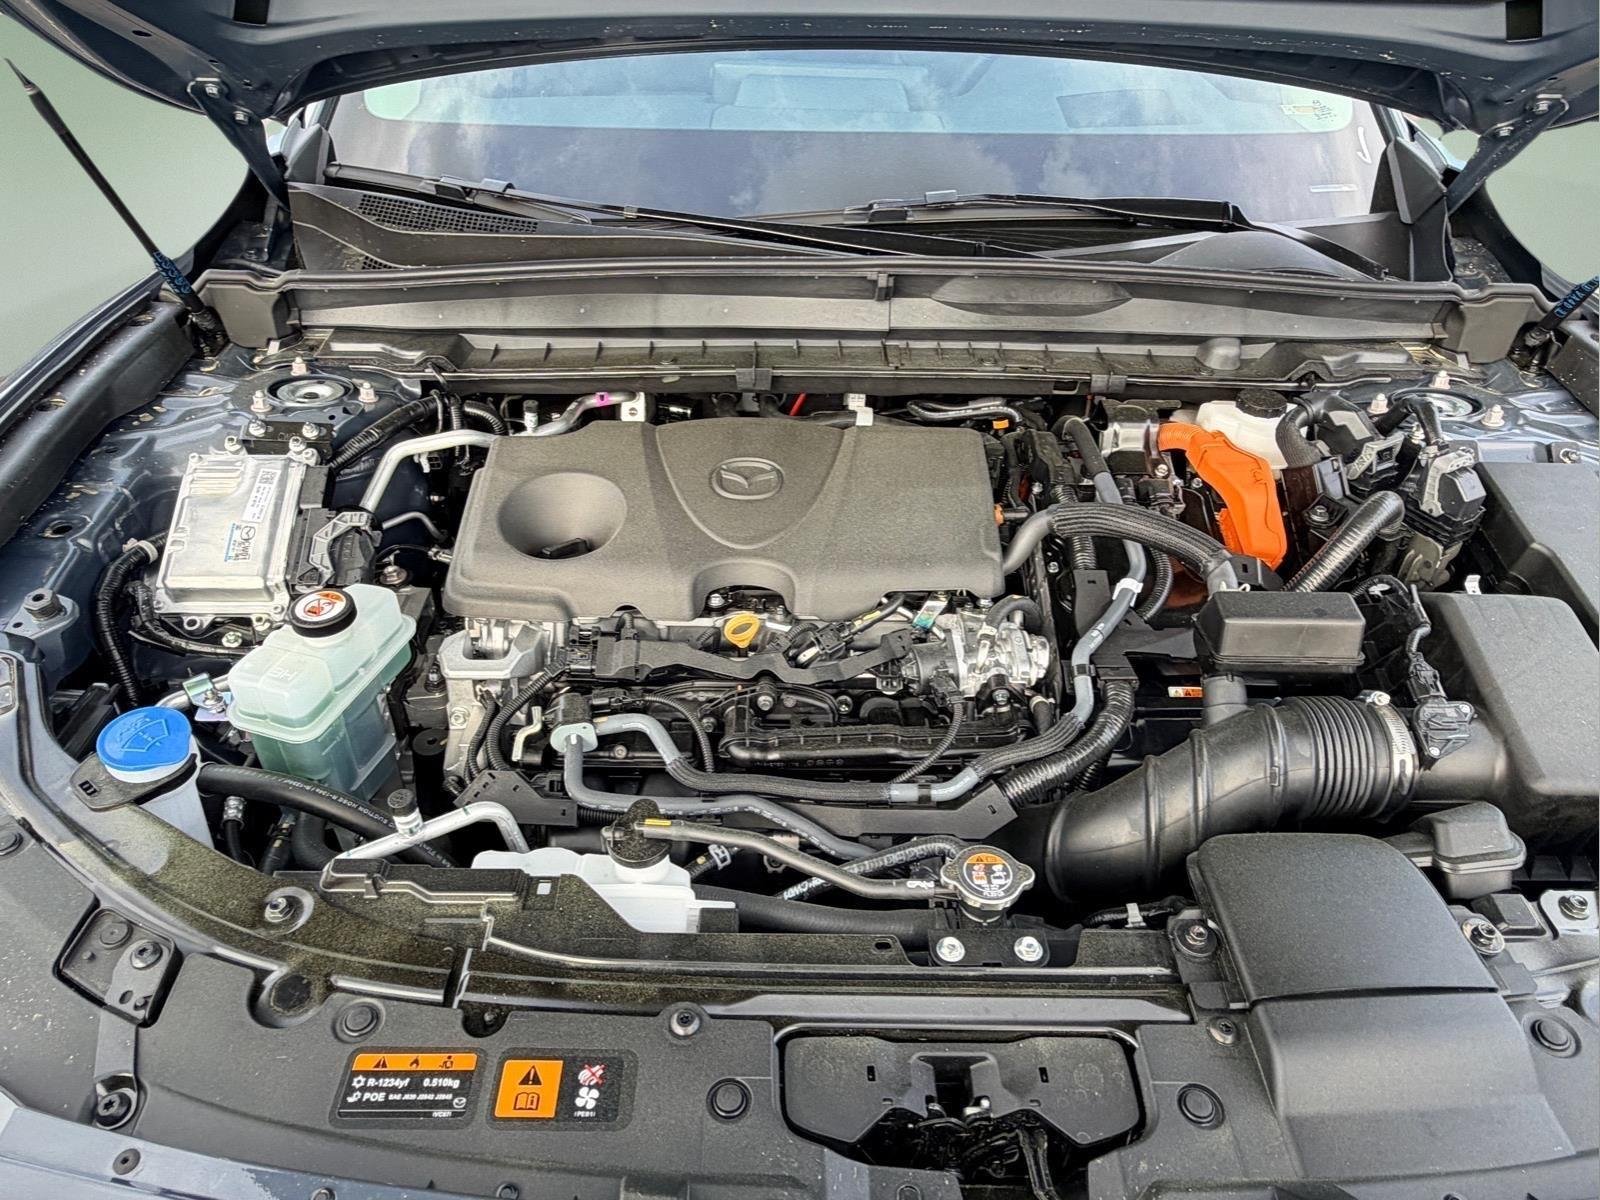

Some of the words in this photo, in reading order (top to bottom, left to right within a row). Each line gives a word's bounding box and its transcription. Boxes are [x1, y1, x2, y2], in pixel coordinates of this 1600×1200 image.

[366, 1077, 411, 1089] R-1234yf
[422, 1077, 461, 1089] 0.510kg
[362, 1091, 387, 1102] POE
